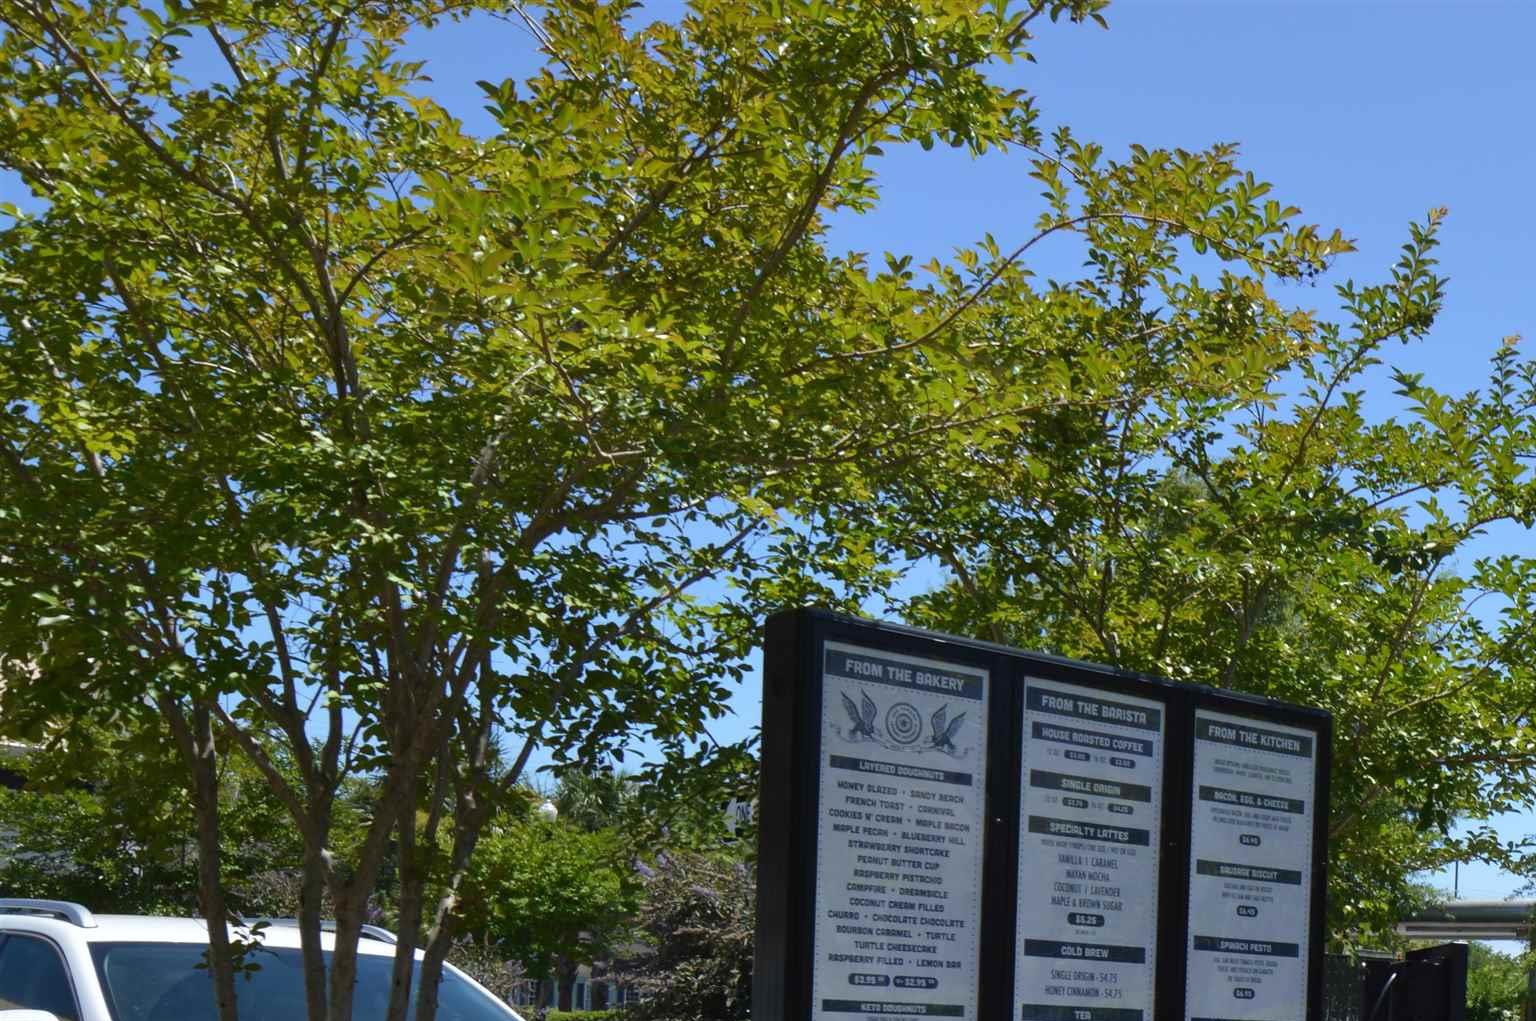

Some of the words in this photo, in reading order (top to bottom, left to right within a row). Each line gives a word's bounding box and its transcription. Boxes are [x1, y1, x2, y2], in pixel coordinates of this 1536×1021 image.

[846, 659, 882, 676] FROM
[887, 666, 912, 682] THE
[916, 671, 964, 690] BAKERY
[1041, 695, 1073, 712] FROM
[1077, 701, 1098, 716] THE
[1102, 705, 1146, 724] BARISTA
[1042, 727, 1070, 740] HOUSE
[1072, 732, 1110, 747] ROASTED
[1112, 738, 1144, 752] COFFEE
[1208, 724, 1235, 740] FROM
[1239, 730, 1260, 744] THE
[1261, 734, 1300, 751] KITCHEN
[859, 761, 895, 774] LAYERED
[838, 780, 864, 791] HONEY
[866, 784, 897, 795] GLAZED
[911, 790, 936, 800] SANDY
[938, 793, 964, 804] BEACH
[845, 795, 876, 806] FRENCH
[879, 800, 904, 810] TOAST
[918, 804, 954, 816] CARNIVAL
[829, 807, 862, 819] COOKIES
[875, 813, 902, 824] CREAM
[916, 818, 942, 829] MAPLE
[944, 822, 970, 832] BACON
[833, 823, 860, 833] MAPLE
[863, 826, 888, 836] PECAN
[902, 831, 945, 843] BLUEBERRY
[948, 836, 967, 845] HILL
[1048, 822, 1095, 836] SPECIALTY
[1097, 828, 1129, 840] LATTES
[848, 839, 900, 852] STRAWBERRY
[904, 845, 951, 858] SHORTCAKE
[856, 855, 888, 865] PEANUT
[891, 858, 921, 868] BUTTER
[924, 862, 939, 870] CUP
[1058, 854, 1083, 865] VANILLA
[1092, 857, 1118, 868] CARAMEL
[854, 868, 899, 880] RASPBERRY
[902, 873, 943, 884] PISTACHIO
[847, 882, 886, 893] CAMPFIRE
[1090, 885, 1120, 896] LAVENDER
[849, 896, 885, 907] COCONUT
[888, 900, 915, 910] CREAM
[919, 903, 944, 912] FILLED
[827, 909, 860, 920] CHURRO
[872, 913, 917, 924] CHOCOLATE
[920, 917, 963, 928] CHOCOLATE
[835, 924, 873, 935] BOURBON
[875, 927, 912, 938] CARAMEL
[925, 931, 957, 941] TURTLE
[853, 940, 885, 950] TURTLE
[888, 942, 936, 953] CHEESECAKE
[1060, 946, 1082, 956] COLD
[1084, 947, 1109, 957] BREW
[828, 952, 873, 963] RASPBERRY
[876, 956, 903, 965] FILLED
[917, 958, 944, 967] LEMON
[946, 960, 962, 969] BAR
[1074, 1010, 1092, 1020] TEA
